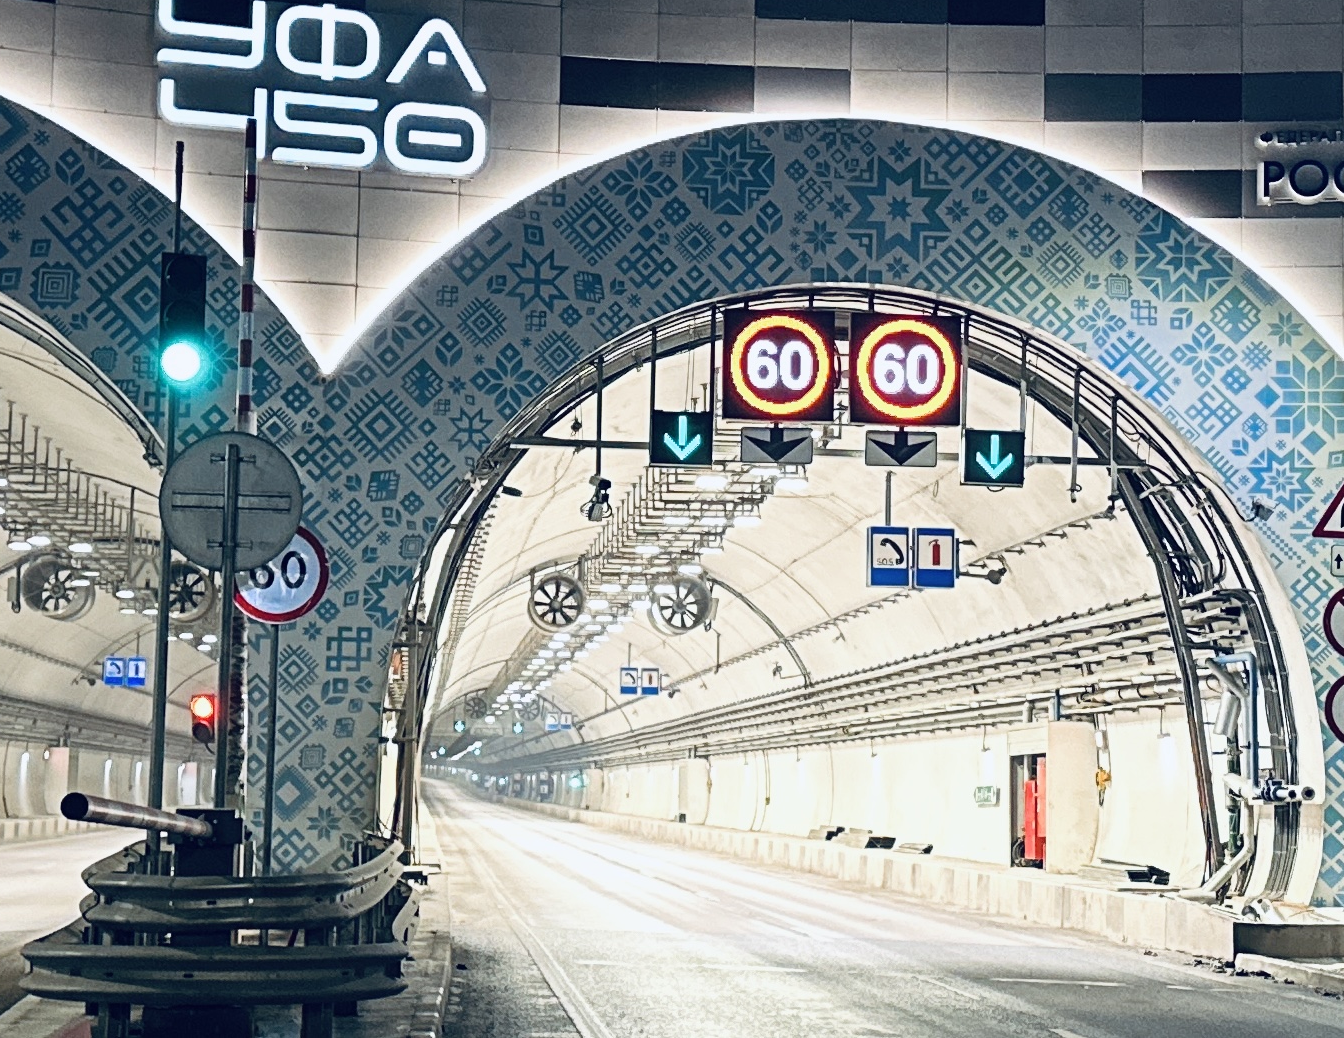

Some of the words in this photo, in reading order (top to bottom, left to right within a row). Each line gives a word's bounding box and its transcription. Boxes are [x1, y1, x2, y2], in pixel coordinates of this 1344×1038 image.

[158, 79, 487, 176] 450
[746, 339, 814, 391] 60
[872, 343, 940, 395] 60
